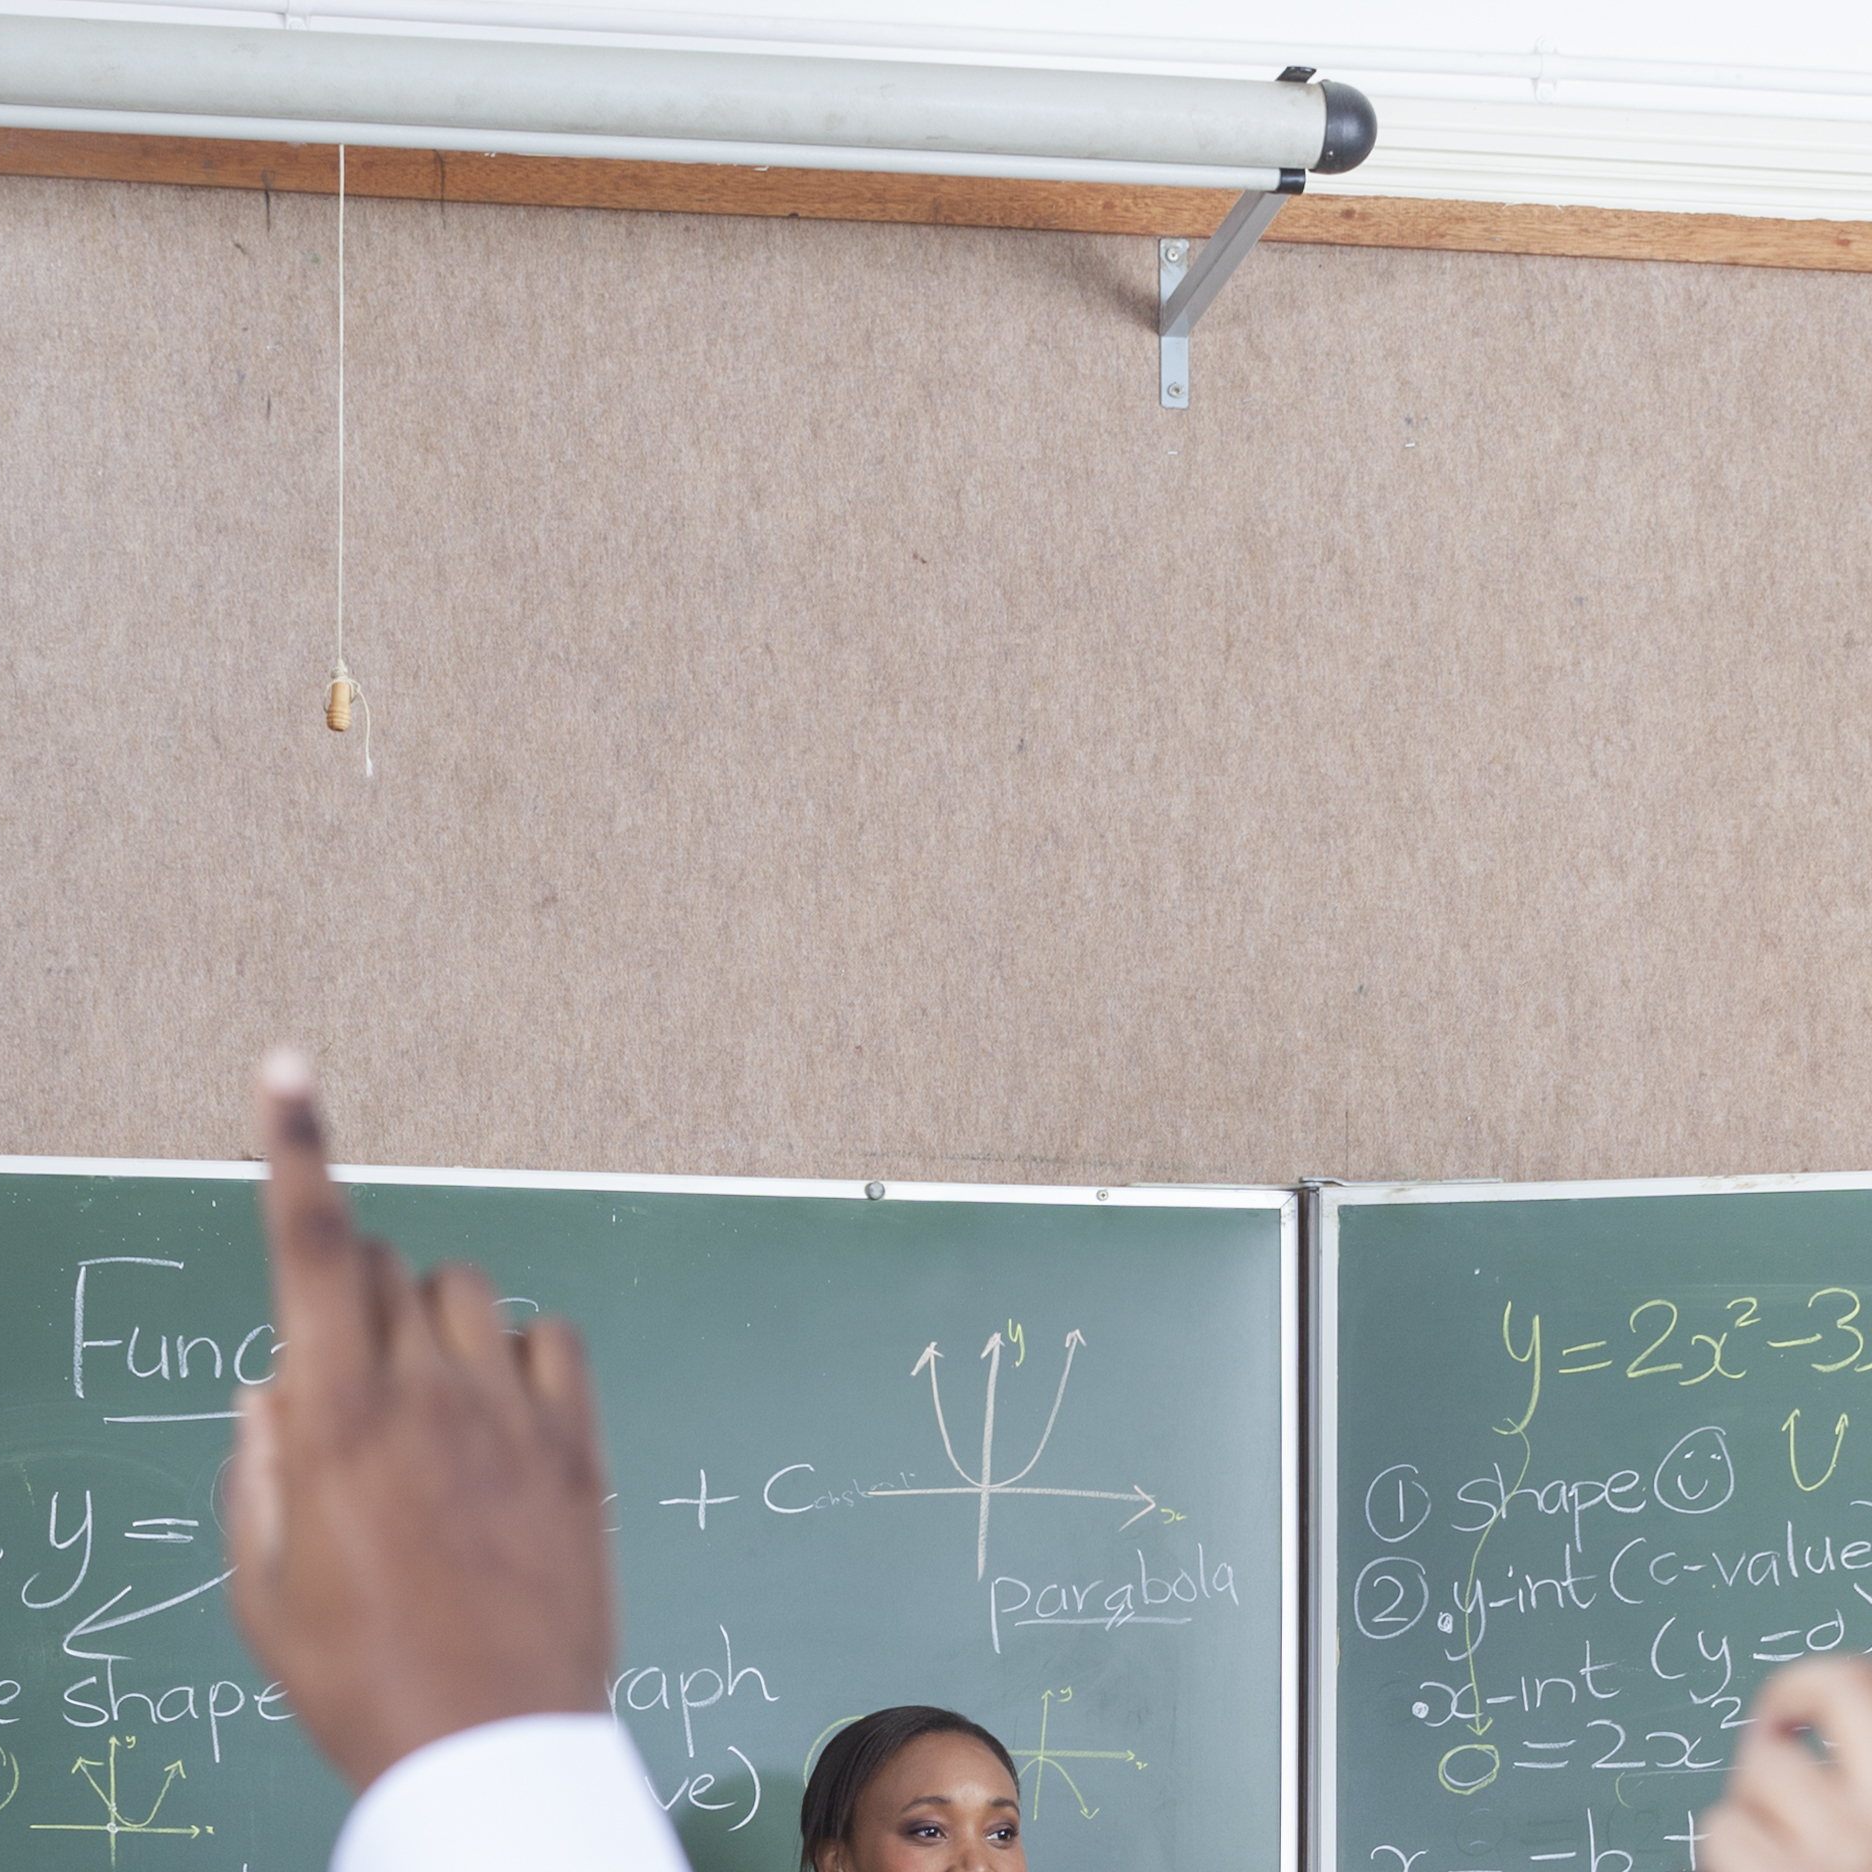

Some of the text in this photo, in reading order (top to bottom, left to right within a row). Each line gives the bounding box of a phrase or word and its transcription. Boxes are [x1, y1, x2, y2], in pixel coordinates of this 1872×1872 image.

[75, 1256, 286, 1399] Func
[1450, 1462, 1647, 1552] shape
[990, 1542, 1240, 1656] parabola
[62, 1655, 298, 1764] shape
[605, 1622, 781, 1758] raph
